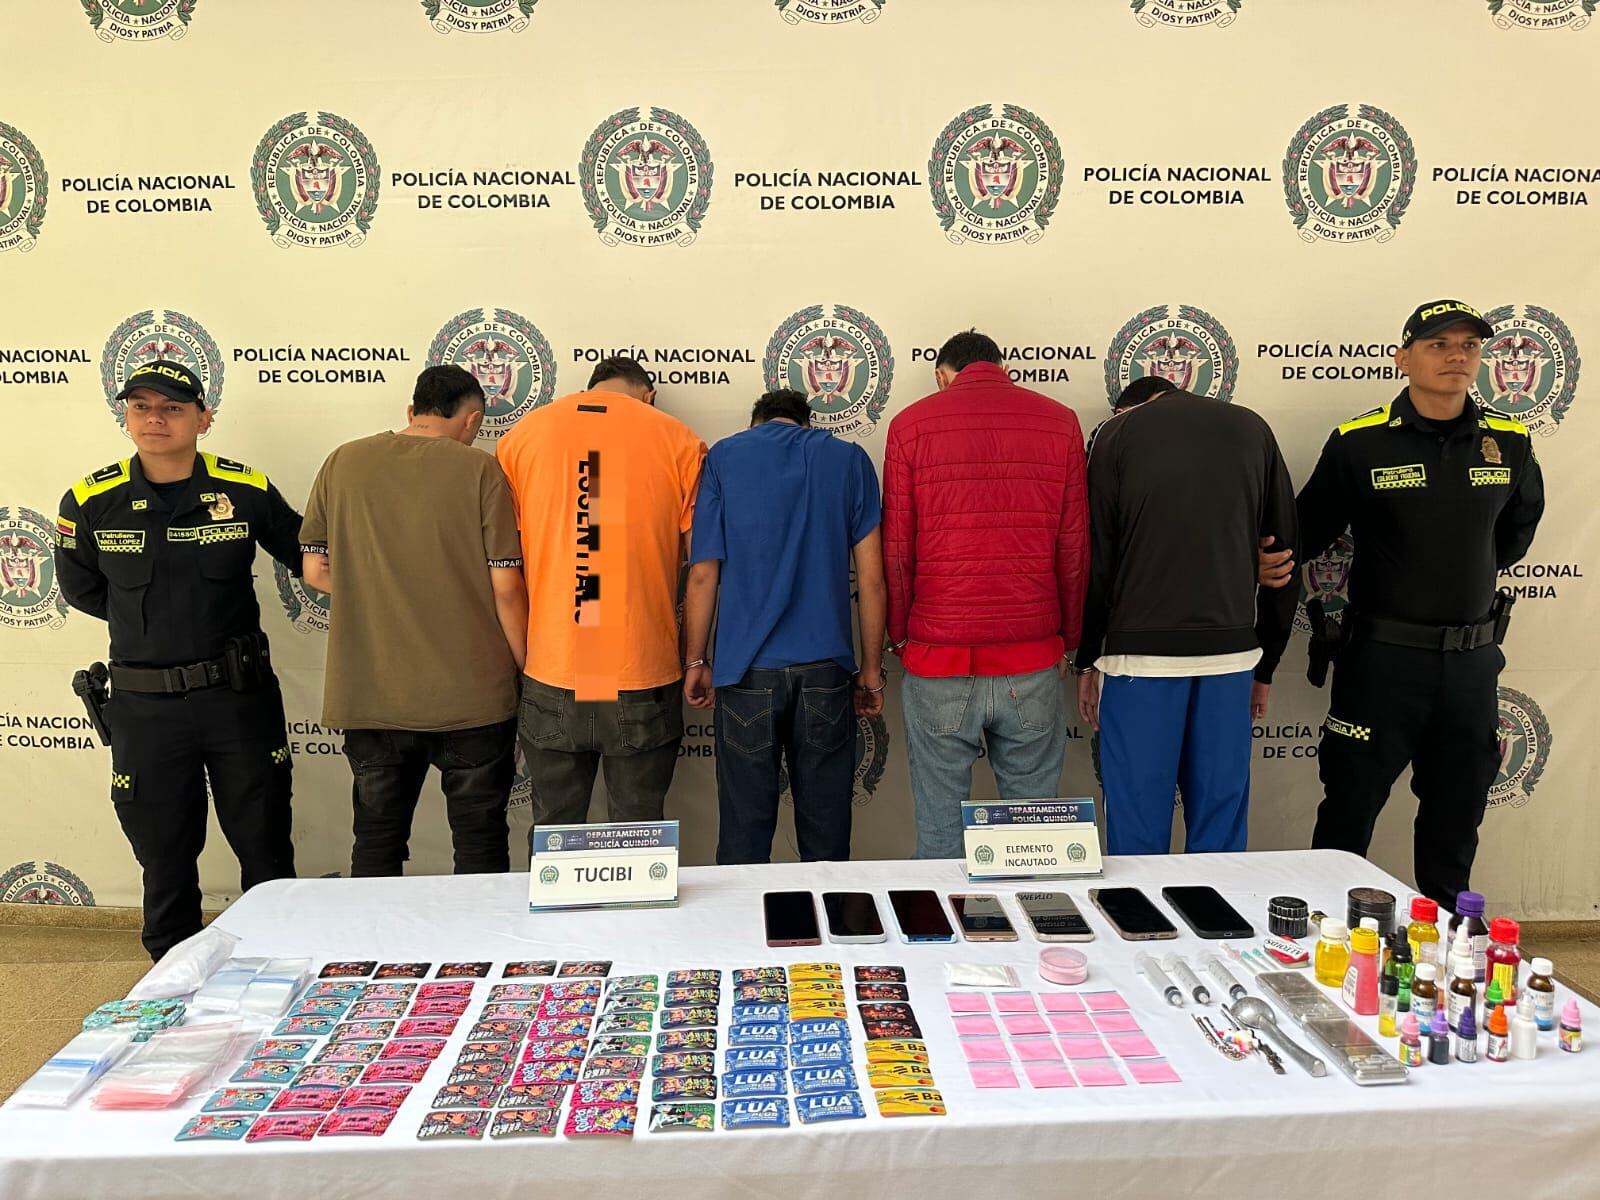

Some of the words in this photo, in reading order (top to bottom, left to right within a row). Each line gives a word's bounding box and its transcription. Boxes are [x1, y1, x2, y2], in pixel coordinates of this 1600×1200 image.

[102, 0, 130, 24] OLICIA
[831, 4, 866, 20] PATRIA
[1186, 8, 1222, 24] PATRIA
[1542, 11, 1577, 26] PATRIA
[142, 21, 174, 38] PATRIA
[481, 14, 514, 30] PATRIA
[596, 128, 630, 184] REPUBLICA
[665, 129, 697, 184] COLOMBIA
[946, 126, 980, 182] REPUBLICA
[992, 120, 1006, 128] DE
[1016, 126, 1047, 182] COLOMBIA
[1300, 126, 1336, 182] REPUBLICA
[1347, 120, 1362, 128] DE
[1372, 126, 1400, 182] COLOMBIA
[2, 140, 34, 192] COLOMBIA
[268, 132, 298, 188] REPUBLICA
[332, 133, 365, 187] COLOMBIA
[392, 169, 468, 186] POLICÍA
[474, 171, 575, 185] NACIONAL
[735, 169, 812, 187] POLICÍA
[818, 172, 921, 186] NACIONAL
[1084, 164, 1161, 181] POLICÍA
[1168, 168, 1271, 181] NACIONAL
[1433, 164, 1508, 181] POLICÍA
[62, 174, 133, 191] POLICÍA
[139, 175, 235, 190] NACIONAL
[418, 195, 441, 208] DE
[448, 194, 550, 208] COLOMBIA
[761, 196, 784, 210] DE
[791, 195, 895, 209] COLOMBIA
[1110, 191, 1133, 204] DE
[1140, 191, 1244, 204] COLOMBIA
[1457, 191, 1481, 204] DE
[1487, 191, 1587, 205] COLOMBIA
[87, 200, 110, 213] DE
[116, 198, 212, 212] COLOMBIA
[950, 195, 984, 226] POLICIA
[996, 194, 1042, 228] NACIONAL
[1303, 194, 1336, 226] POLICIA
[1348, 194, 1394, 226] NACIONAL
[0, 205, 31, 236] ACIONAL
[274, 200, 308, 230] POLICIA
[320, 199, 362, 232] NACIONAL
[602, 198, 636, 229] POLICIA
[648, 197, 692, 230] NACIONAL
[320, 229, 352, 245] PATRIA
[648, 228, 682, 244] PATRIA
[994, 225, 1030, 241] PATRIA
[1346, 224, 1381, 240] PATRIA
[0, 234, 23, 249] ATRIA
[0, 350, 91, 362] NACIONAL
[117, 330, 145, 383] REPUBLICA
[178, 331, 208, 382] COLOMBIA
[234, 345, 305, 361] POLICÍA
[312, 348, 410, 361] NACIONAL
[508, 330, 540, 382] COLOMBIA
[655, 349, 755, 362] NACIONAL
[780, 326, 812, 379] REPUBLICA
[848, 326, 878, 378] COLOMBIA
[1122, 326, 1158, 380] REPUBLICA
[1168, 320, 1182, 328] DE
[1192, 326, 1222, 379] COLOMBIA
[1258, 341, 1333, 357] POLICÍA
[1340, 344, 1399, 359] NACIO
[1513, 320, 1528, 328] DE
[1537, 326, 1564, 378] COLOMBIA
[0, 371, 68, 383] LOMBIA
[259, 370, 281, 383] DE
[287, 370, 385, 382] COLOMBIA
[646, 370, 730, 385] OLOMBIA
[1008, 368, 1069, 383] OMBIA
[1283, 367, 1306, 379] DE
[494, 394, 537, 425] NACIONAL
[829, 390, 874, 422] NACIONAL
[9, 520, 22, 528] DE
[1499, 585, 1557, 599] OMBIA
[24, 586, 59, 614] NACIONAL
[296, 590, 328, 618] POLICIA
[24, 613, 53, 627] PATRIA
[306, 616, 329, 630] DIOS
[26, 717, 95, 730] NACION
[1251, 722, 1312, 739] OLICÍA
[1510, 706, 1536, 755] COLOMBIA
[8, 735, 94, 749] COLOMBIA
[1263, 746, 1286, 758] DE
[1009, 806, 1067, 814] DEPARTAMENTO
[586, 829, 650, 839] DEPARTAMENTO
[588, 838, 620, 848] POLICÍA
[622, 837, 660, 848] QUINDÍO
[1007, 845, 1053, 853] ELEMENTO
[1006, 858, 1057, 866] INCAUTADO
[574, 867, 631, 882] TUCIBI
[36, 874, 48, 882] DE
[58, 881, 79, 904] COLO
[743, 1006, 779, 1016] LUA
[740, 1027, 778, 1036] LUA
[802, 1023, 840, 1033] LUA
[737, 1050, 776, 1060] LUA
[802, 1043, 841, 1054] LUA
[908, 1044, 926, 1052] Ba
[804, 1070, 846, 1080] LUA
[910, 1066, 931, 1074] Ba
[734, 1074, 776, 1084] LUA
[810, 1096, 852, 1108] LUA
[922, 1092, 944, 1101] Ba
[734, 1102, 778, 1114] LUA
